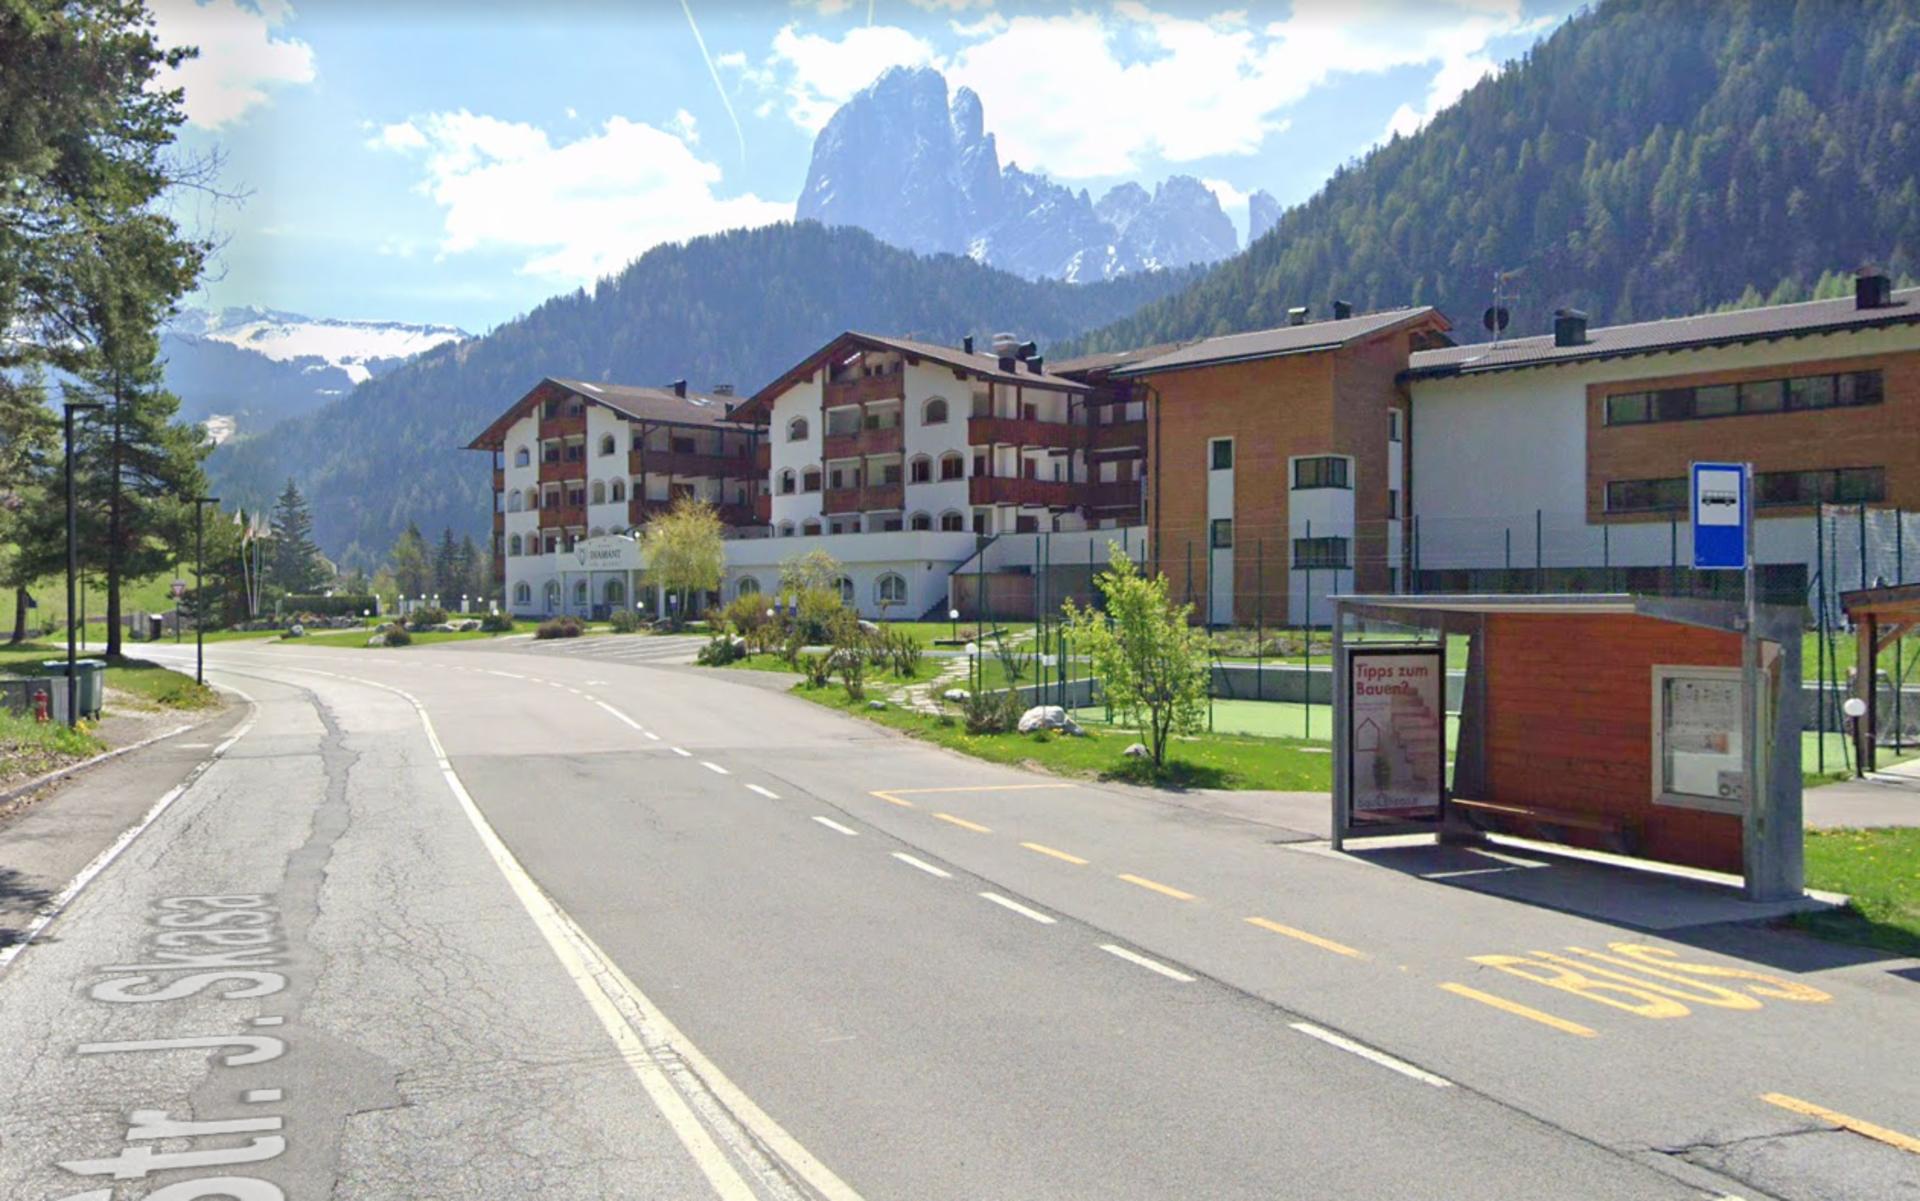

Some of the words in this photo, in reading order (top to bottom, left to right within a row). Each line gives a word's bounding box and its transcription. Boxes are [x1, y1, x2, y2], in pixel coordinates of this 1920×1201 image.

[1356, 663, 1394, 684] Tipps
[1398, 664, 1429, 678] zum
[1356, 681, 1410, 696] Bauen?
[1465, 941, 1834, 1019] BUS
